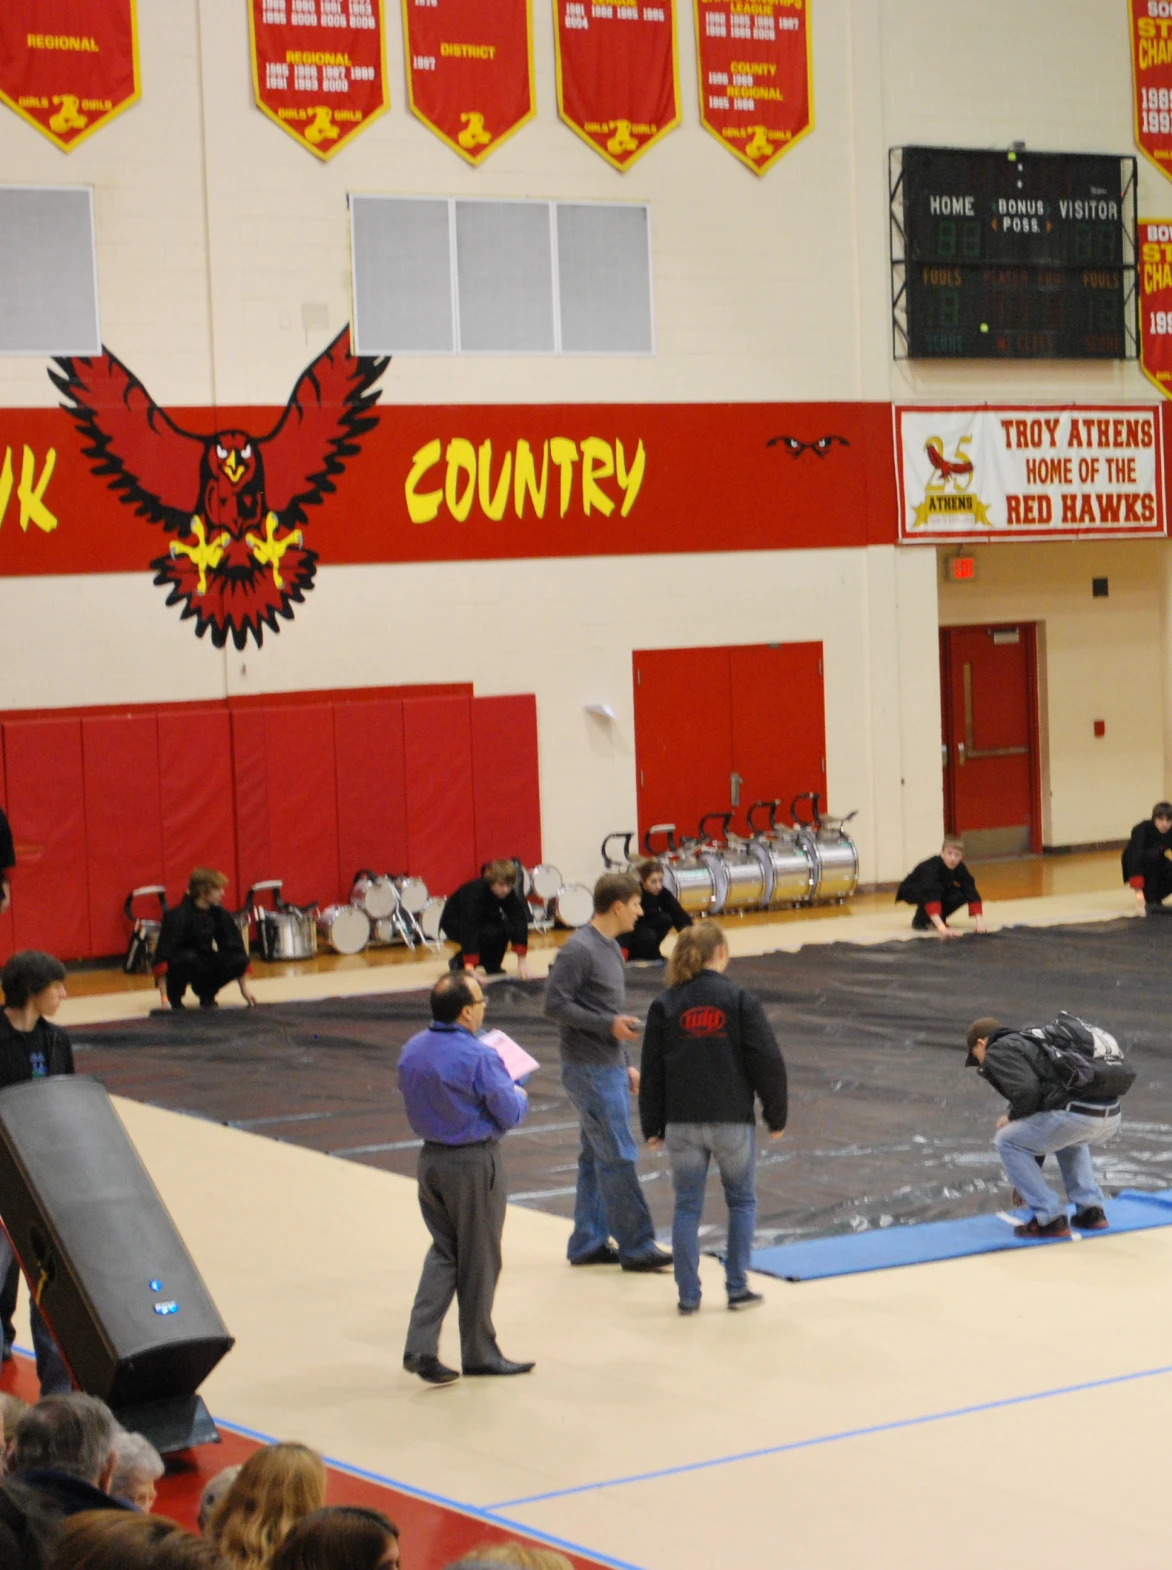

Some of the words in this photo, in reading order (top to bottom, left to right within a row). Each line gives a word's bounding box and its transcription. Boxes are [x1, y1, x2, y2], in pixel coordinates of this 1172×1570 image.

[730, 2, 775, 16] LEAGUE
[26, 33, 100, 53] REGIONAL
[440, 42, 496, 60] DISTRICT
[285, 50, 353, 67] REGIONAL
[730, 61, 777, 77] COUNTY
[726, 85, 785, 102] REGIONAL
[929, 196, 975, 217] HOME
[998, 199, 1045, 216] BONUS
[1058, 200, 1119, 221] VISITOR
[1002, 216, 1041, 233] POSS.
[922, 267, 963, 288] FOULS
[1083, 271, 1121, 290] FOULS
[1001, 418, 1061, 449] TROY
[1066, 418, 1154, 449] ATHENS
[405, 437, 646, 524] COUNTRY
[1025, 458, 1073, 485] HOME
[1078, 459, 1100, 484] OF
[1105, 457, 1137, 484] THE
[929, 496, 974, 512] ATHENS
[1005, 493, 1053, 526] RED
[1061, 492, 1156, 525] HAWKS
